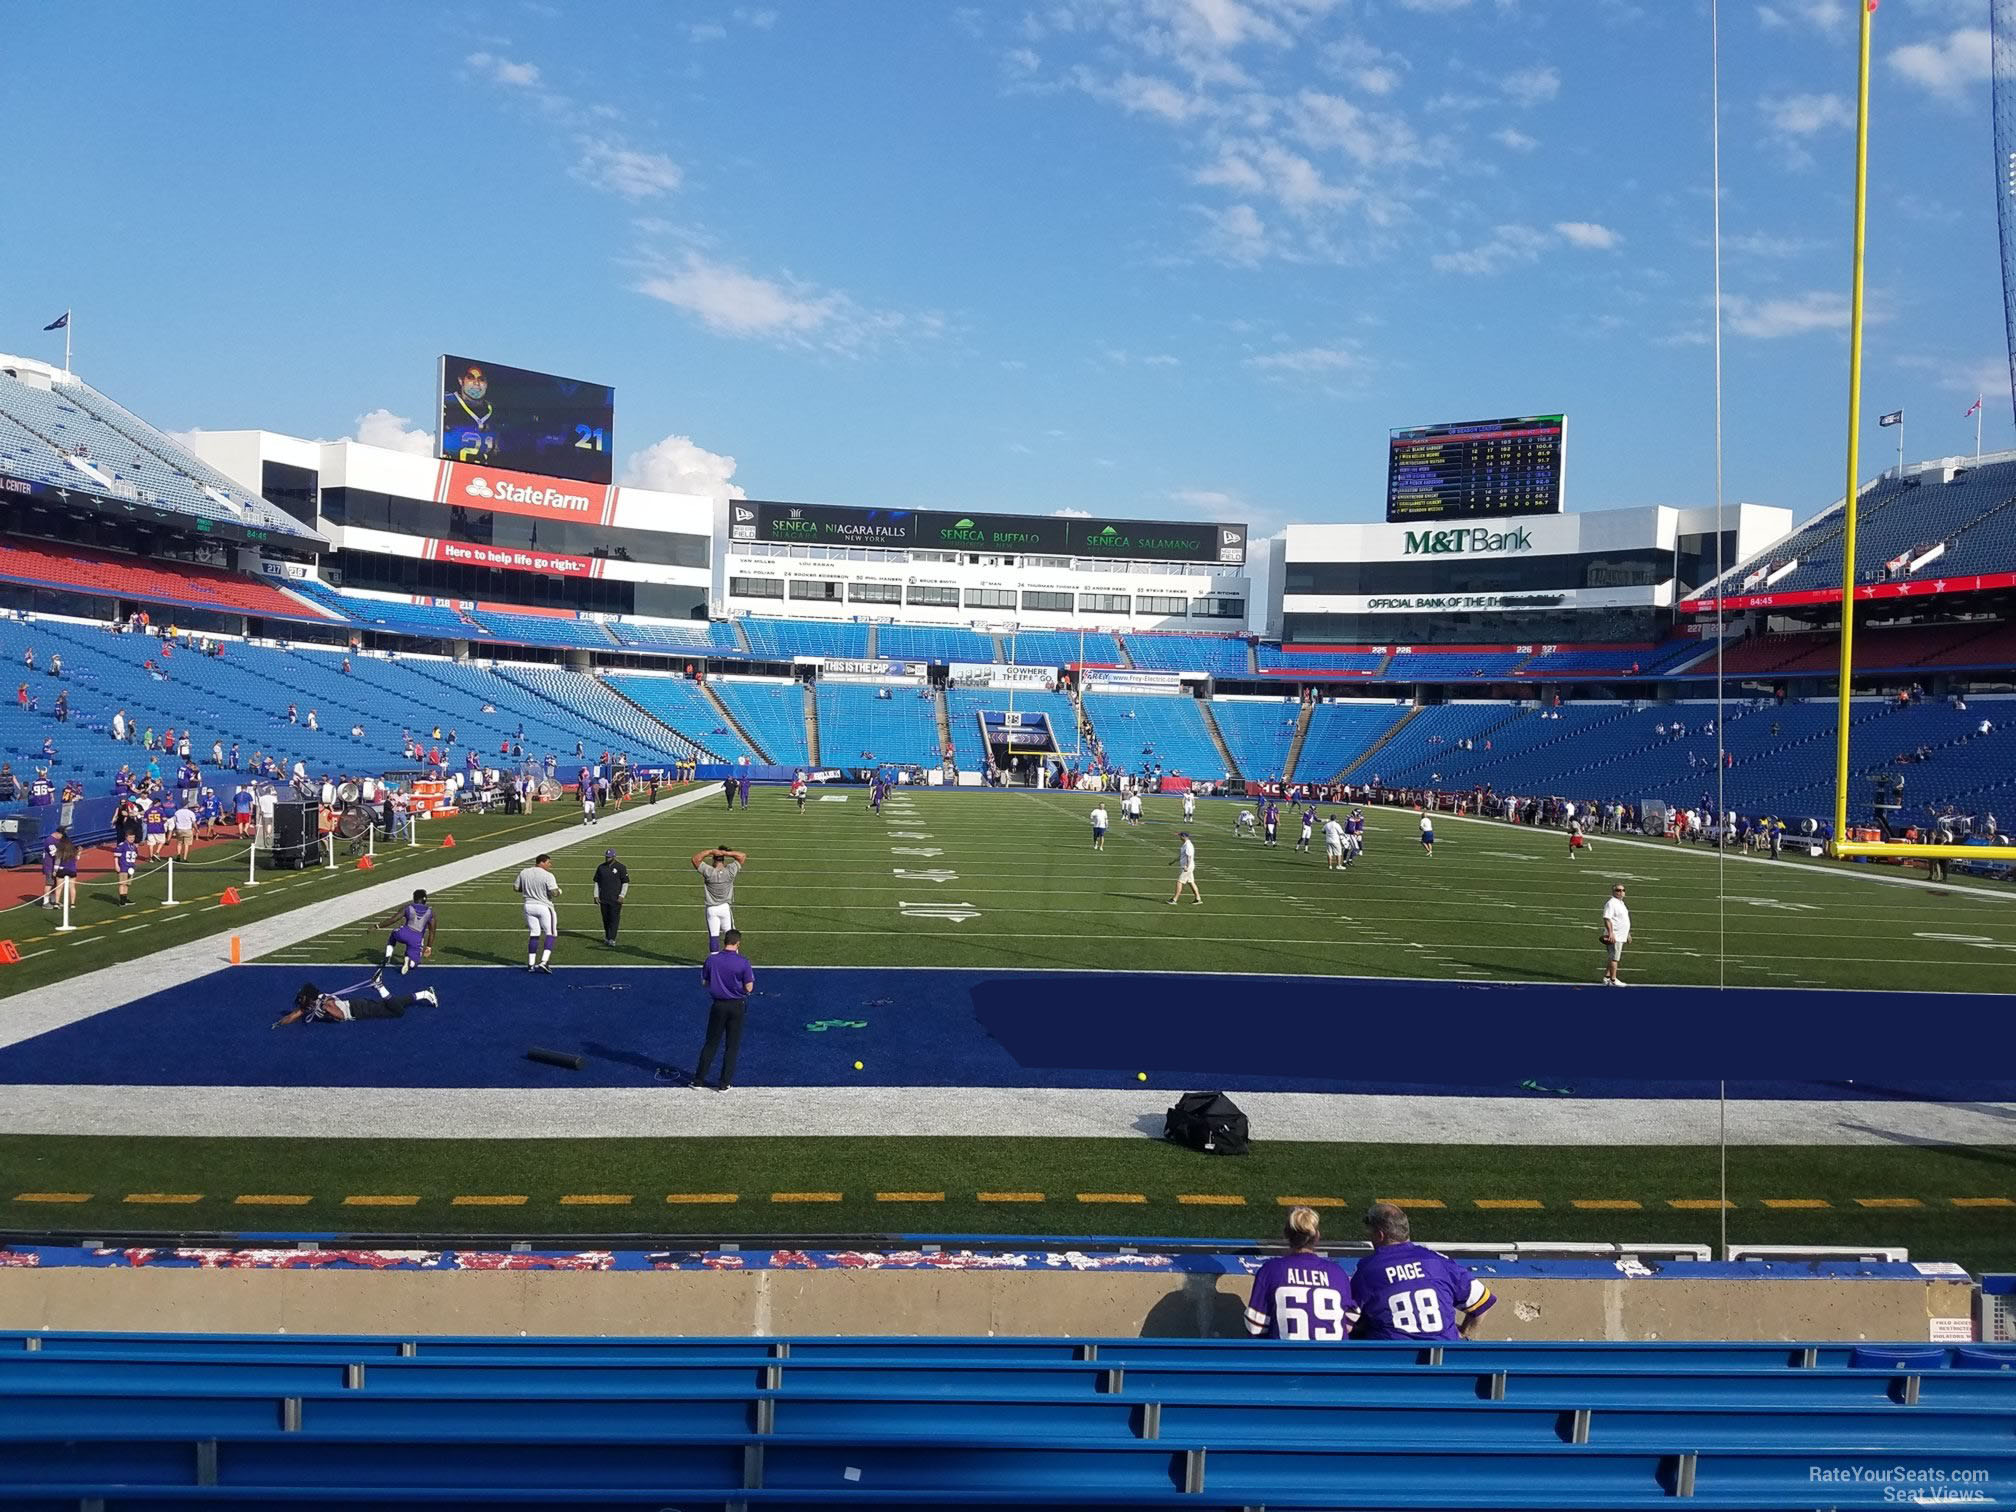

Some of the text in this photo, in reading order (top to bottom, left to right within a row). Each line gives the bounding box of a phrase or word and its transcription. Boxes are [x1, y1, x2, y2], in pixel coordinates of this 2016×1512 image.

[575, 424, 603, 451] 21
[6, 479, 32, 495] CENTER
[772, 520, 818, 532] SENECA
[826, 524, 906, 538] NIAGARA FALLS
[940, 529, 985, 542] SENECA
[993, 533, 1040, 544] BUFFALO
[1087, 536, 1130, 548] SENECA
[445, 545, 472, 560] Here
[475, 549, 486, 560] to
[488, 550, 512, 566] help
[514, 553, 532, 567] life
[534, 557, 548, 569] go
[1221, 552, 1241, 560] FIELD
[267, 564, 280, 574] 217
[1368, 598, 1414, 609] OFFICIAL
[1417, 598, 1446, 608] BANK
[1448, 597, 1463, 607] OF
[1464, 596, 1486, 607] THE
[1750, 597, 1772, 606] 84:45
[1688, 624, 1702, 632] 227
[1516, 646, 1532, 654] 226
[1542, 645, 1557, 653] 227
[825, 661, 889, 674] THIS IS THE CAP
[1113, 673, 1180, 682] www.Frey-Electric.com
[33, 785, 48, 796] 96
[148, 814, 160, 823] 55
[1288, 1268, 1330, 1287] ALLEN
[1386, 1261, 1425, 1284] PAGE
[1276, 1286, 1344, 1341] 69
[1388, 1288, 1443, 1334] 88
